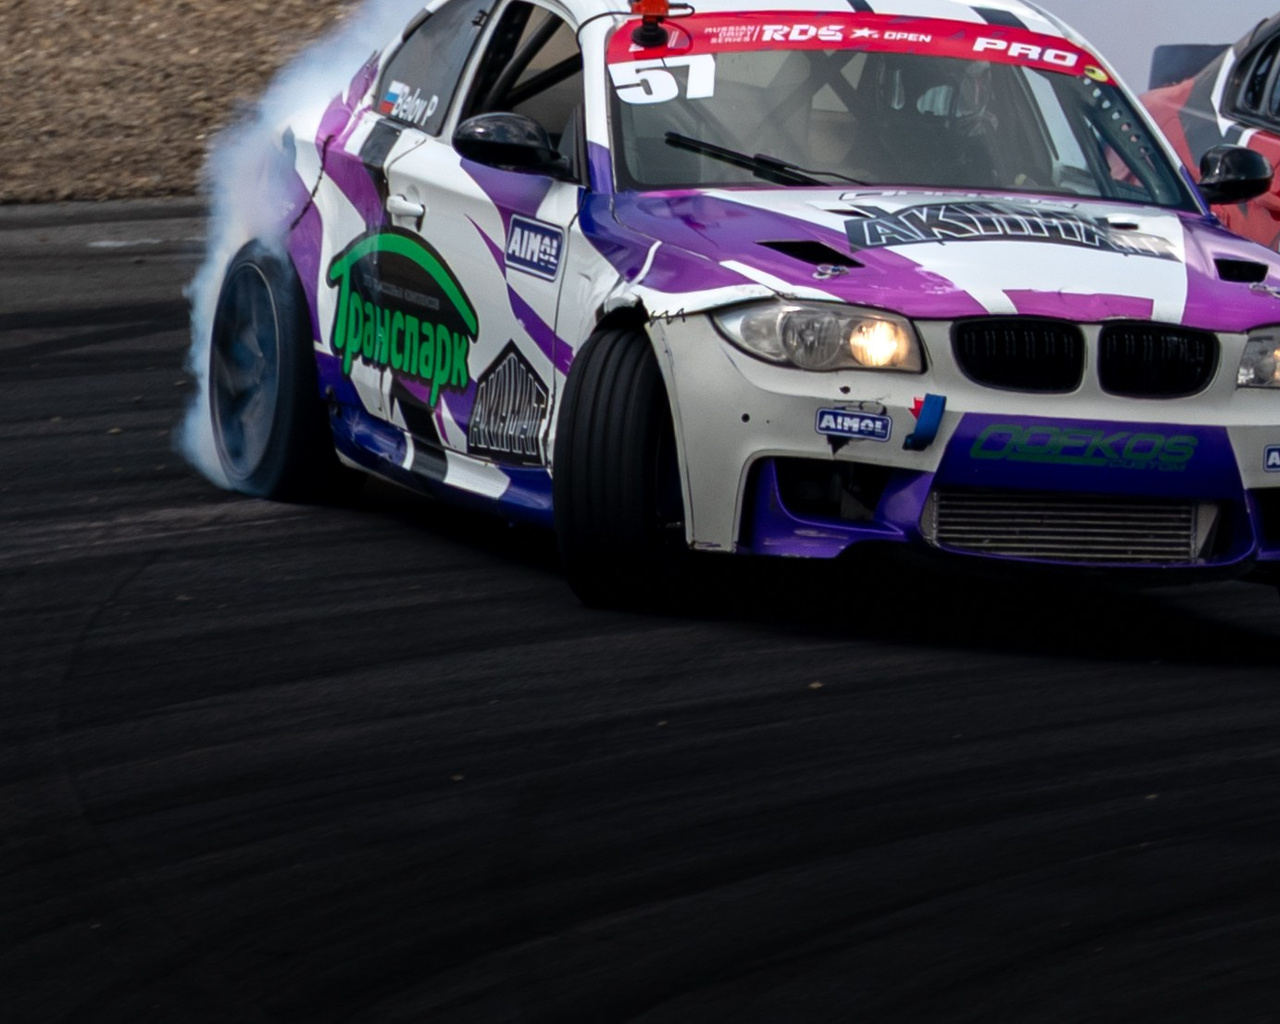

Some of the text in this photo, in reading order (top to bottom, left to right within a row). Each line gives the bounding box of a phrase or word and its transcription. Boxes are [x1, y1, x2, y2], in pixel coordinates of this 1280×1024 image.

[762, 24, 846, 42] RDS
[883, 32, 932, 43] OPEN
[972, 37, 1079, 68] PRO
[508, 226, 558, 265] AIMOL
[330, 244, 472, 407] Транспарк
[819, 414, 886, 434] AIMOL
